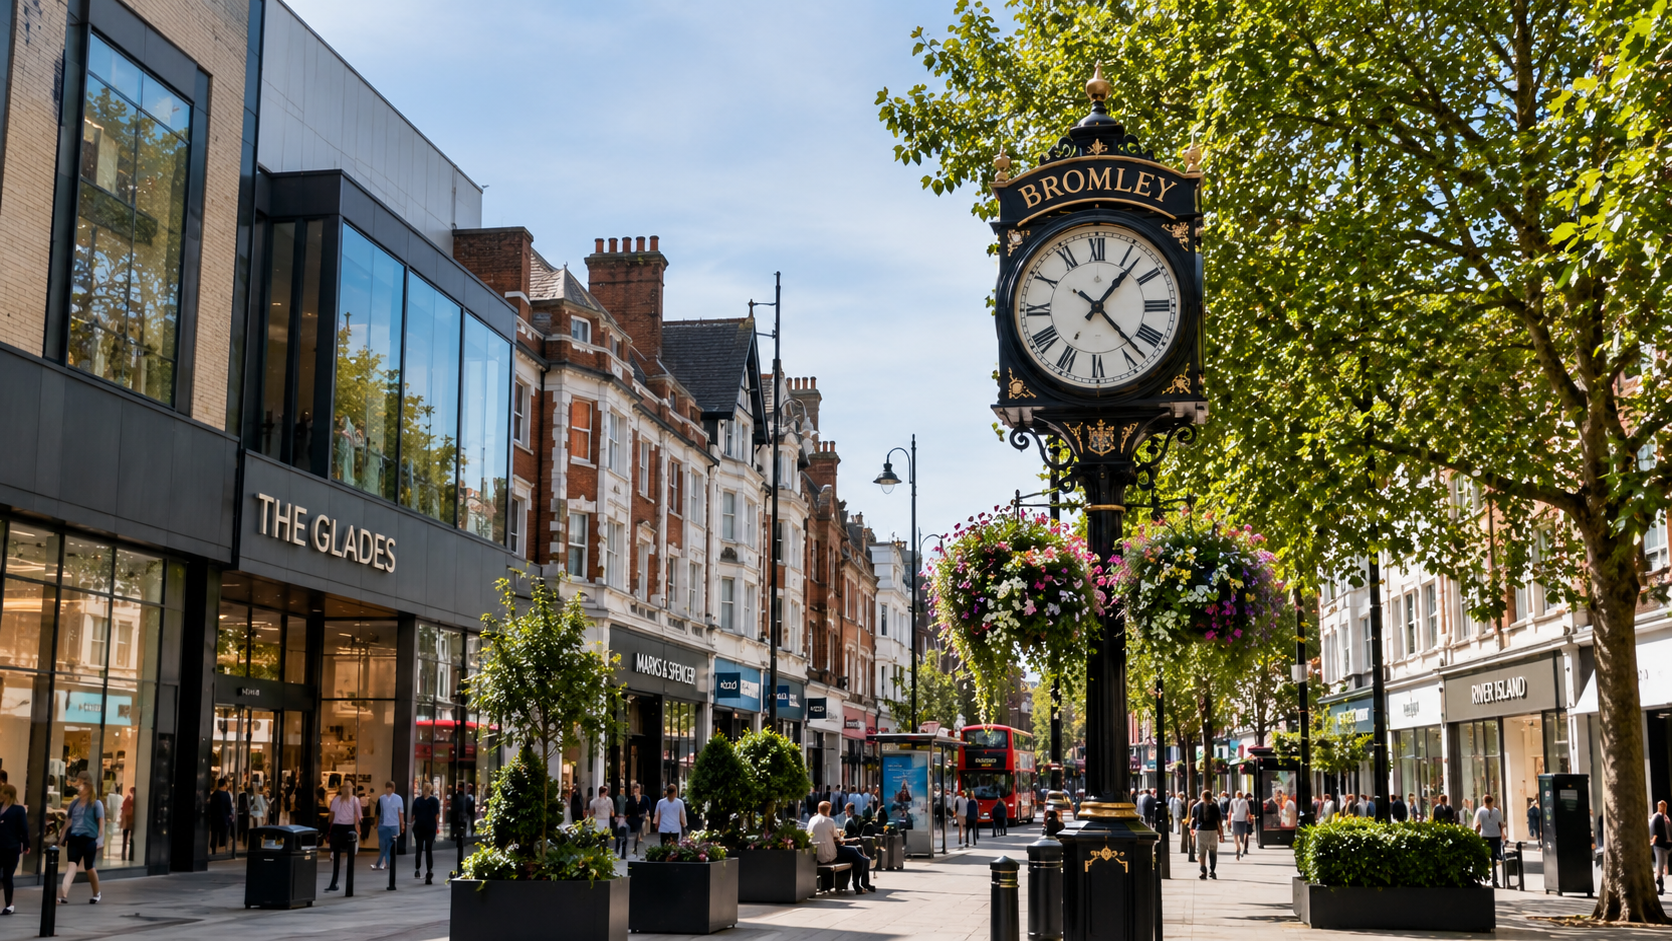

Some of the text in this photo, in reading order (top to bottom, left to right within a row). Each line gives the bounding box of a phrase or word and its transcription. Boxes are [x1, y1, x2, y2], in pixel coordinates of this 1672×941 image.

[1018, 167, 1177, 209] BROMLEY
[1056, 245, 1078, 271] XI
[1088, 237, 1106, 262] XII
[1119, 245, 1134, 267] I
[1034, 271, 1058, 289] X
[1136, 267, 1161, 286] II
[1026, 303, 1051, 316] IX
[1144, 299, 1170, 312] III
[1032, 325, 1059, 354] VIII
[1135, 323, 1163, 348] IIII
[1056, 345, 1078, 373] VII
[1092, 354, 1105, 378] VI
[1121, 348, 1138, 370] V
[258, 492, 396, 573] THE GLADES
[636, 652, 662, 677] MARKS
[662, 660, 668, 678] &
[668, 661, 696, 685] SPENCER
[1471, 676, 1526, 704] RIVER ISLAND
